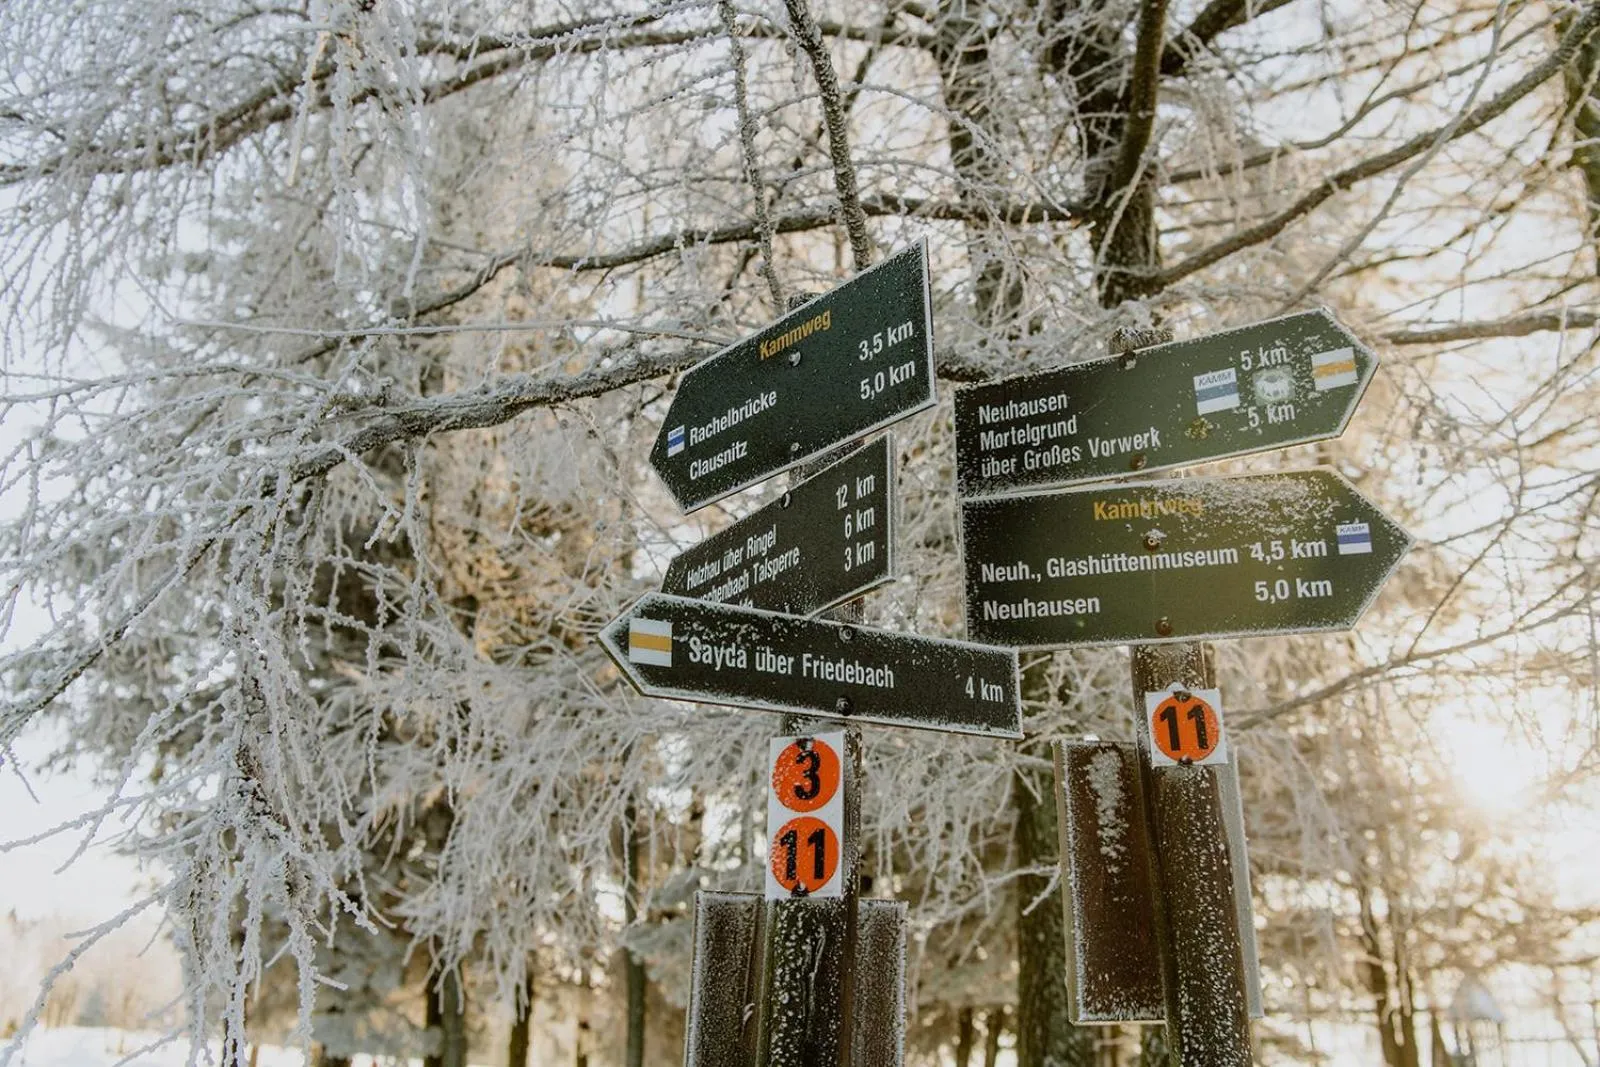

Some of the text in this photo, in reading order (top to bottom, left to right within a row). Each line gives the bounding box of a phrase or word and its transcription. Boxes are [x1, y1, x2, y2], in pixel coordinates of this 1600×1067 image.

[760, 310, 832, 360] Kammweg
[1240, 346, 1289, 371] 5 km
[689, 319, 914, 446] Rachelbrücke 3,5 km
[689, 360, 916, 481] Clausnitz 5,0 km
[978, 393, 1068, 425] Neuhausen
[980, 415, 1078, 452] Mortelgrund
[1248, 403, 1296, 428] 5 km
[981, 426, 1162, 479] über Großes Vorwerk
[723, 545, 744, 571] über
[746, 523, 777, 559] Ringel
[836, 484, 848, 510] 12
[856, 474, 875, 500] km
[753, 546, 800, 584] Talsperre
[844, 513, 852, 540] 6
[856, 507, 875, 533] km
[844, 540, 875, 572] 3 km
[981, 539, 1328, 583] Neuh., Glashüttenmuseum 4,5 km
[983, 578, 1333, 621] Neuhausen 5,0 km
[688, 636, 1004, 703] Sayda über Friedebach 4 km
[1160, 704, 1209, 752] 11
[794, 750, 821, 801] 3
[780, 828, 826, 881] 11
